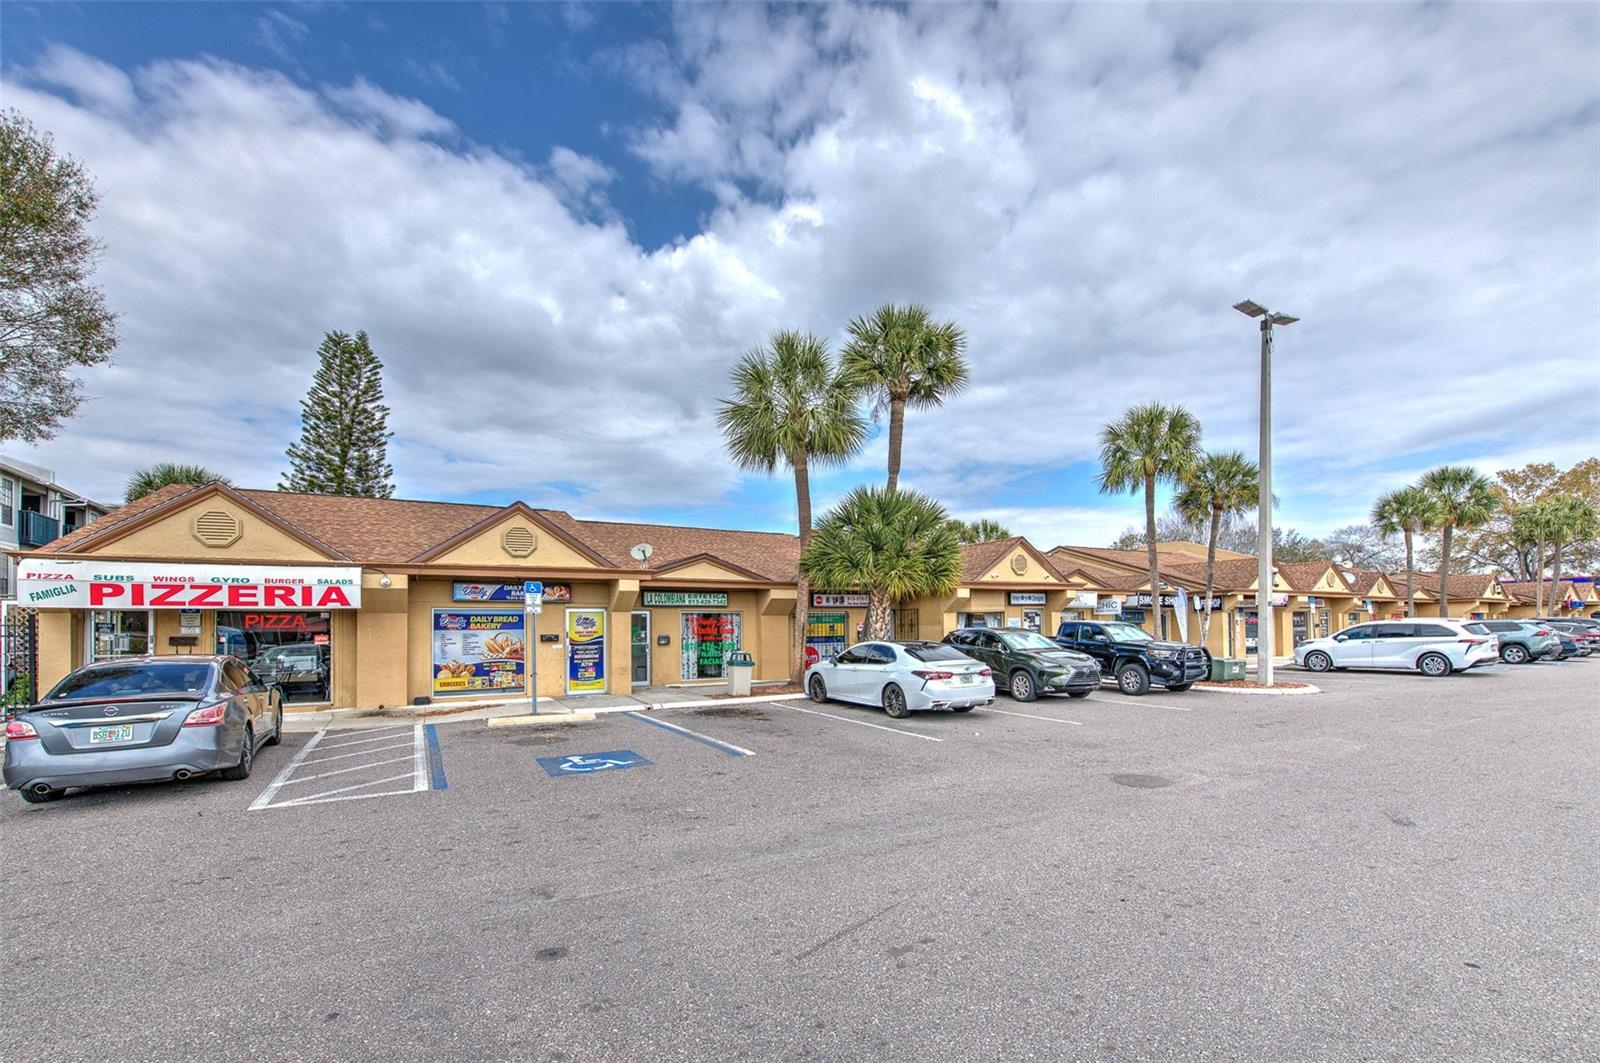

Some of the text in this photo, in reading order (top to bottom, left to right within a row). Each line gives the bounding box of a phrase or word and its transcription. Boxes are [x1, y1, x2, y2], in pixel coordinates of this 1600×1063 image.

[26, 572, 75, 580] PIZZA
[29, 584, 78, 602] FAMIGLIA
[89, 583, 352, 607] PIZZERIA
[1139, 596, 1164, 605] SMOE
[243, 613, 307, 629] PIZZA
